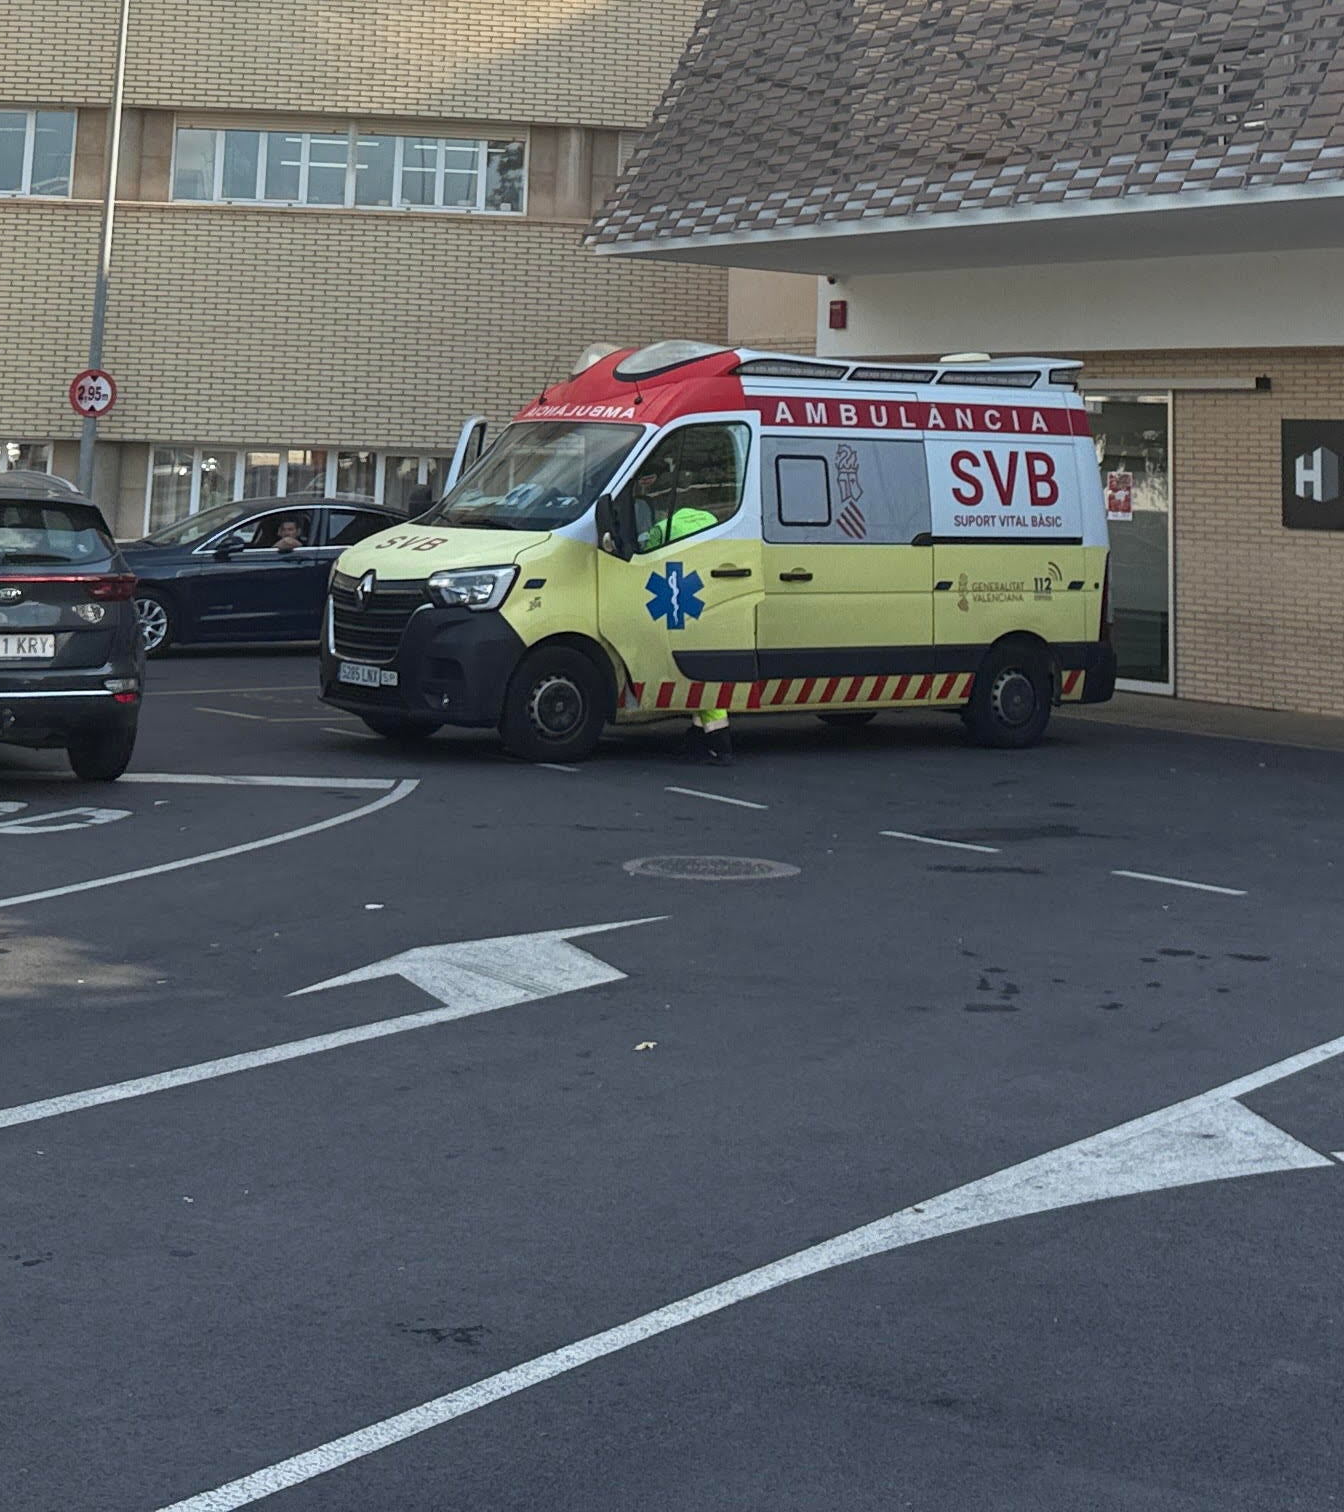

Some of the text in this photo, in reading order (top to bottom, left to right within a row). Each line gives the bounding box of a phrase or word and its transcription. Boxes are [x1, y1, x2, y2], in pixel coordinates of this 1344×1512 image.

[775, 401, 1049, 432] AMBULÀNCIA
[950, 450, 1059, 507] SVB
[954, 513, 1063, 528] SUPORT VITAL BÀSIC
[376, 536, 449, 552] SVB
[971, 578, 1052, 594] GENERALITAT 112
[973, 592, 1025, 603] VALENCIANA
[17, 638, 47, 654] KRY
